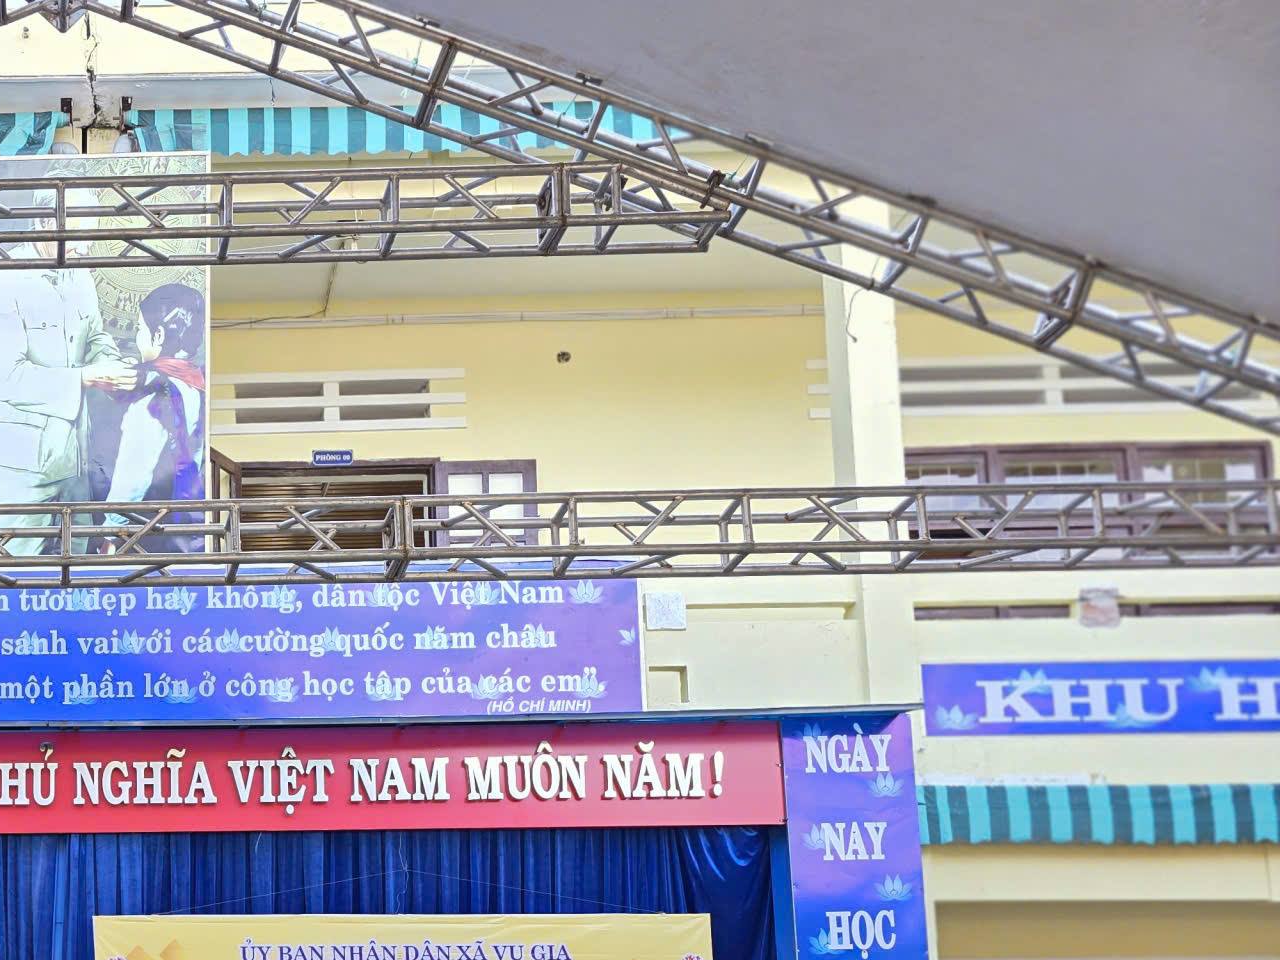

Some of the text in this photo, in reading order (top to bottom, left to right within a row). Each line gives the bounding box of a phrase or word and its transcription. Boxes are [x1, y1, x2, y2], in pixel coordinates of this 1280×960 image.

[19, 589, 72, 611] tươi
[88, 588, 136, 616] đẹp
[146, 587, 197, 615] hay
[206, 586, 303, 613] không,
[313, 585, 366, 608] dân
[377, 584, 420, 611] tộc
[428, 582, 488, 610] Việt
[498, 581, 564, 605] Nam
[1, 630, 68, 655] sánh
[77, 629, 121, 654] vai
[132, 629, 173, 654] với
[182, 628, 228, 653] các
[239, 627, 326, 657] cường
[335, 622, 404, 657] quốc
[414, 625, 476, 650] năm
[486, 623, 557, 649] châu
[0, 674, 54, 704] một
[62, 669, 135, 704] phần
[144, 672, 189, 698] lớn
[199, 671, 216, 697] ở
[225, 672, 294, 702] công
[303, 671, 354, 701] học
[364, 671, 412, 701] tập
[421, 667, 470, 694] của
[484, 667, 531, 694] các
[976, 677, 1184, 724] KHU
[518, 697, 546, 713] CHÍ
[549, 698, 592, 713] MINH)
[803, 722, 892, 774] NGÀY
[73, 748, 218, 805] NGHĨA
[228, 746, 336, 815] VIỆT
[350, 757, 450, 802] NAM
[464, 743, 588, 802] MUÔN
[821, 821, 887, 861] NAY
[403, 940, 451, 960] DÂN
[456, 941, 487, 960] XÃ
[492, 945, 524, 960] VU
[531, 945, 572, 960] GIA
[826, 909, 896, 959] HỌC
